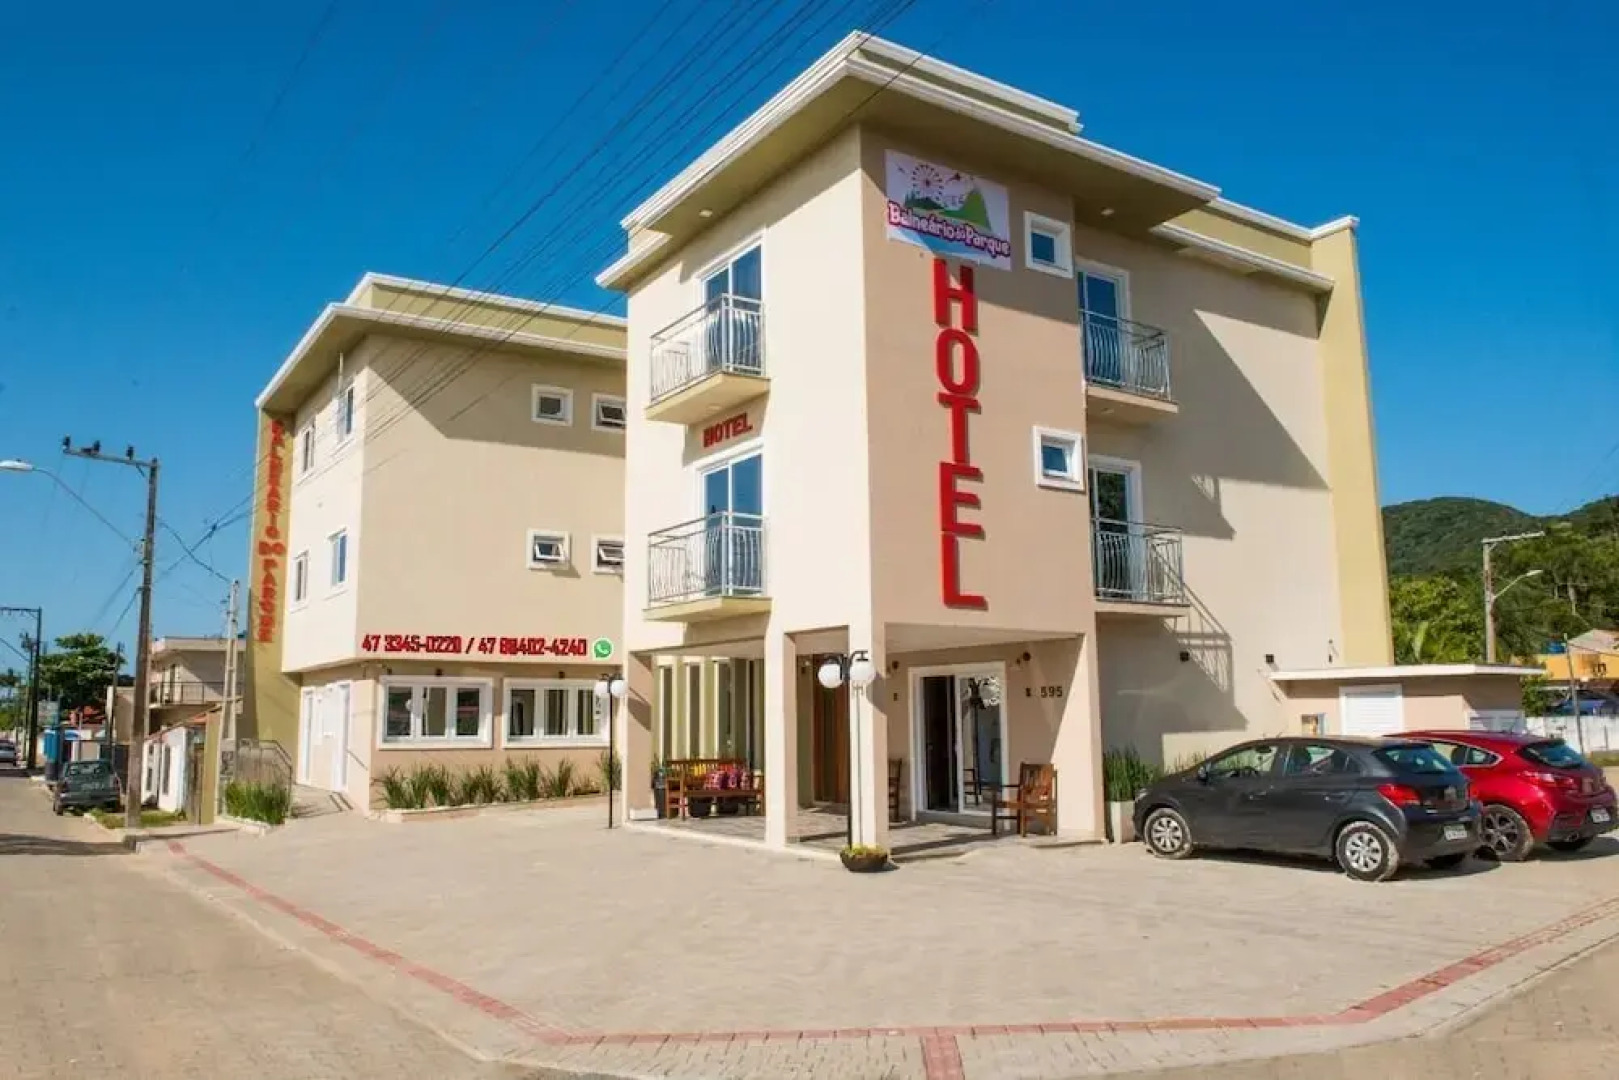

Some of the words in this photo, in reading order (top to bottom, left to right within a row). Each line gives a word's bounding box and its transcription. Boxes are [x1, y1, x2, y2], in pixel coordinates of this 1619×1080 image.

[964, 222, 1011, 258] Parque
[703, 411, 753, 448] HOTEL
[933, 258, 988, 610] HOTEL
[362, 634, 381, 652] 47
[478, 637, 496, 654] 47
[1040, 686, 1063, 698] 595
